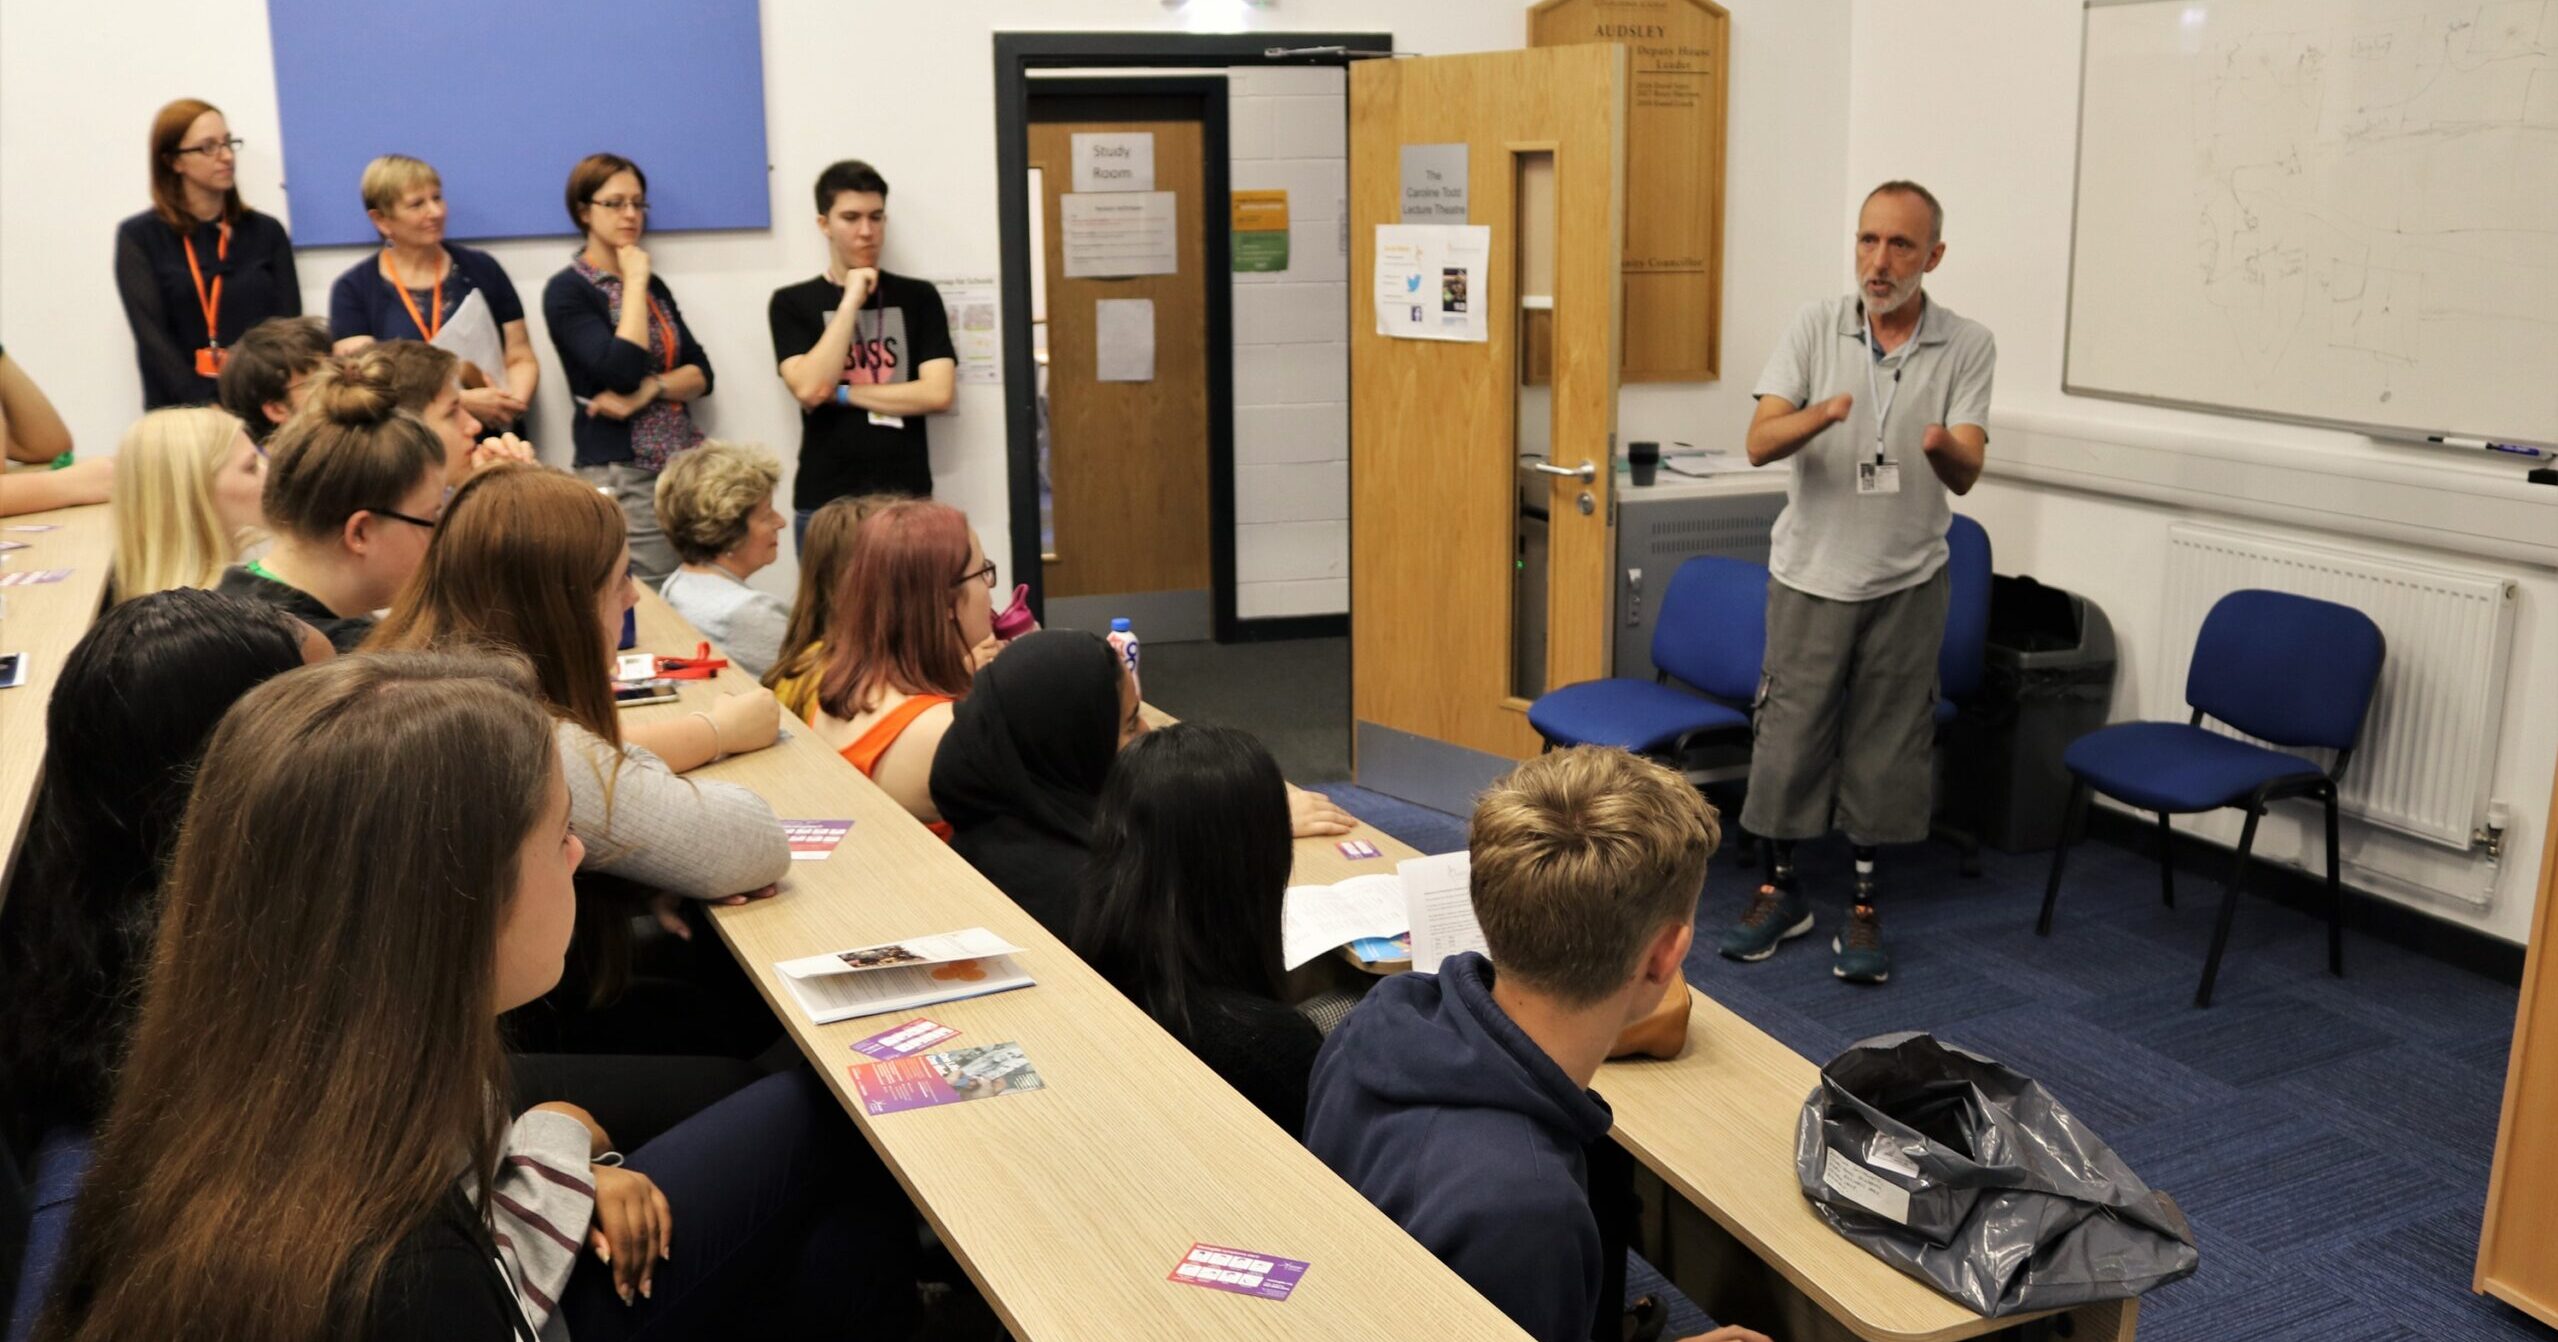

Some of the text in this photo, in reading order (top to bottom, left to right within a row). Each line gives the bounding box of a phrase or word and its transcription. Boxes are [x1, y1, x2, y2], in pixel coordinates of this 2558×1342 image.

[1593, 23, 1666, 38] AUDSLEY
[1093, 145, 1130, 158] Study
[1092, 167, 1133, 179] Room
[1426, 169, 1442, 181] The
